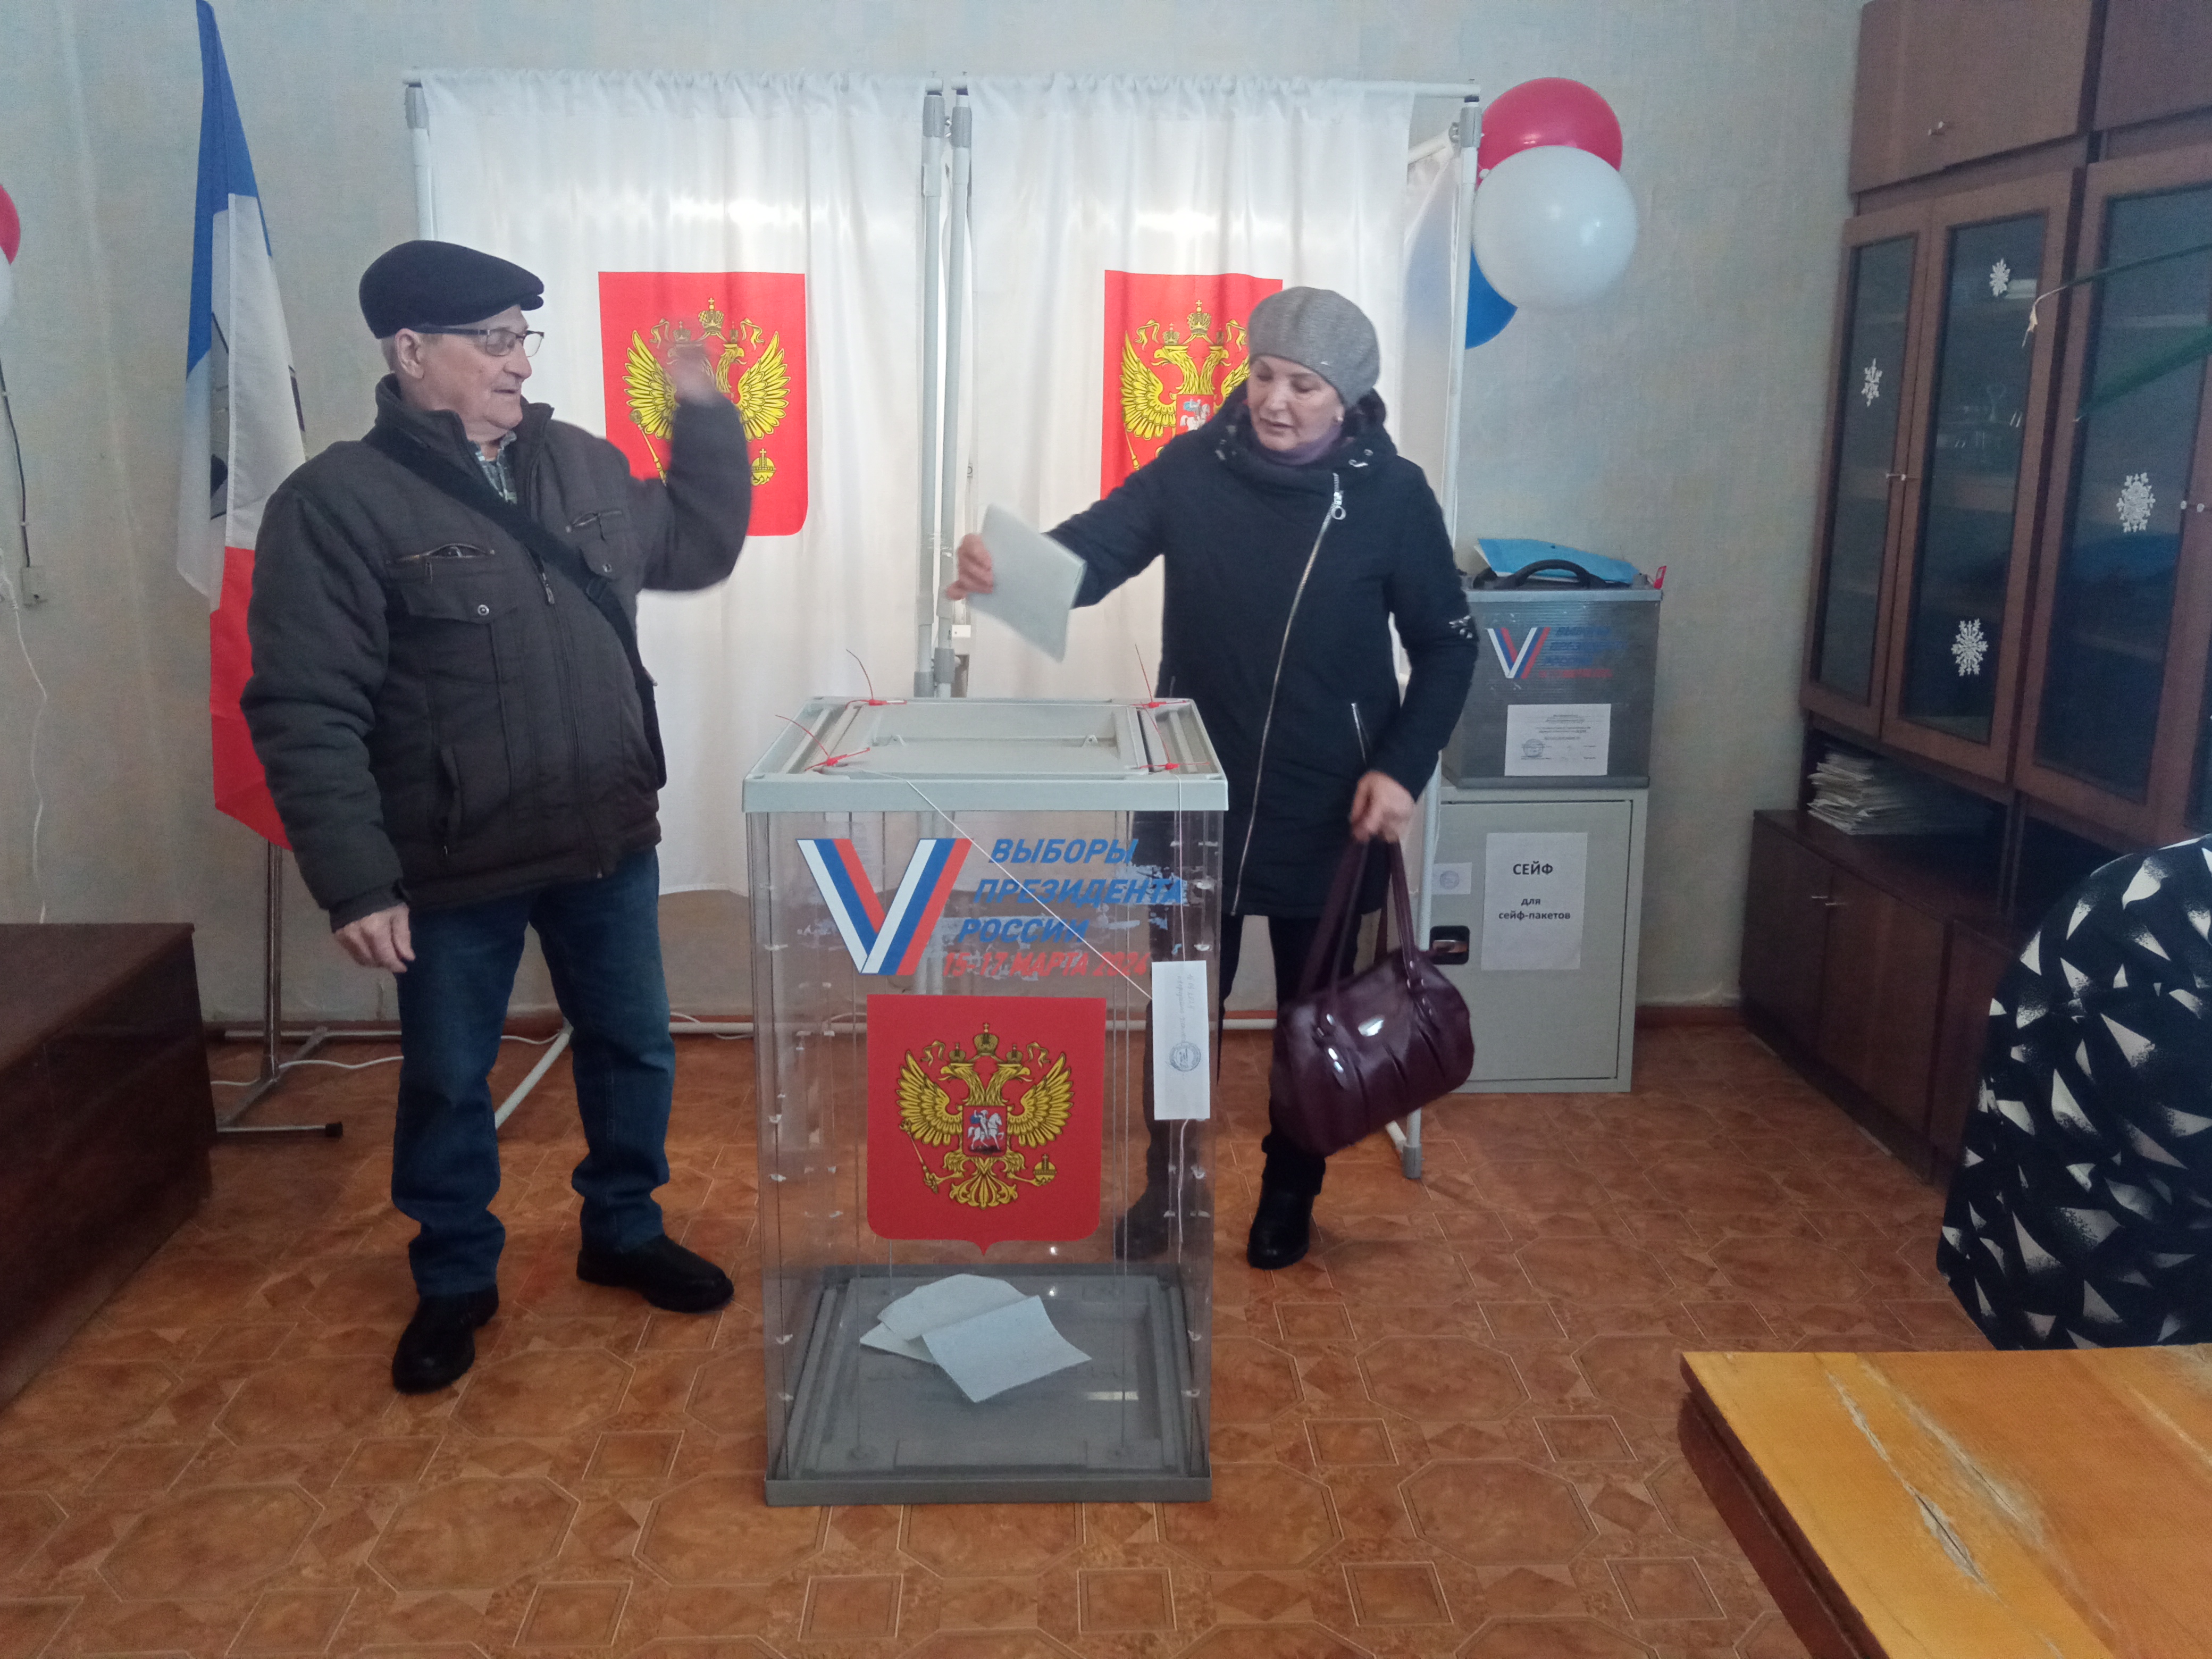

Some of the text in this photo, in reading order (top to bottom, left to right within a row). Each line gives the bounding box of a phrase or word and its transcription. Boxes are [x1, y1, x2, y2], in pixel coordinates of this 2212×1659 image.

[988, 838, 1139, 864] ВЫБОРЫ
[1513, 861, 1553, 875] СЕЙФ
[973, 879, 1184, 908] ПРЕЗИДЕНТА
[1498, 910, 1571, 920] сейф-пакетов
[958, 918, 1090, 943] РОССИИ
[943, 952, 1009, 977] 15-17
[1009, 951, 1090, 977] МАРТА
